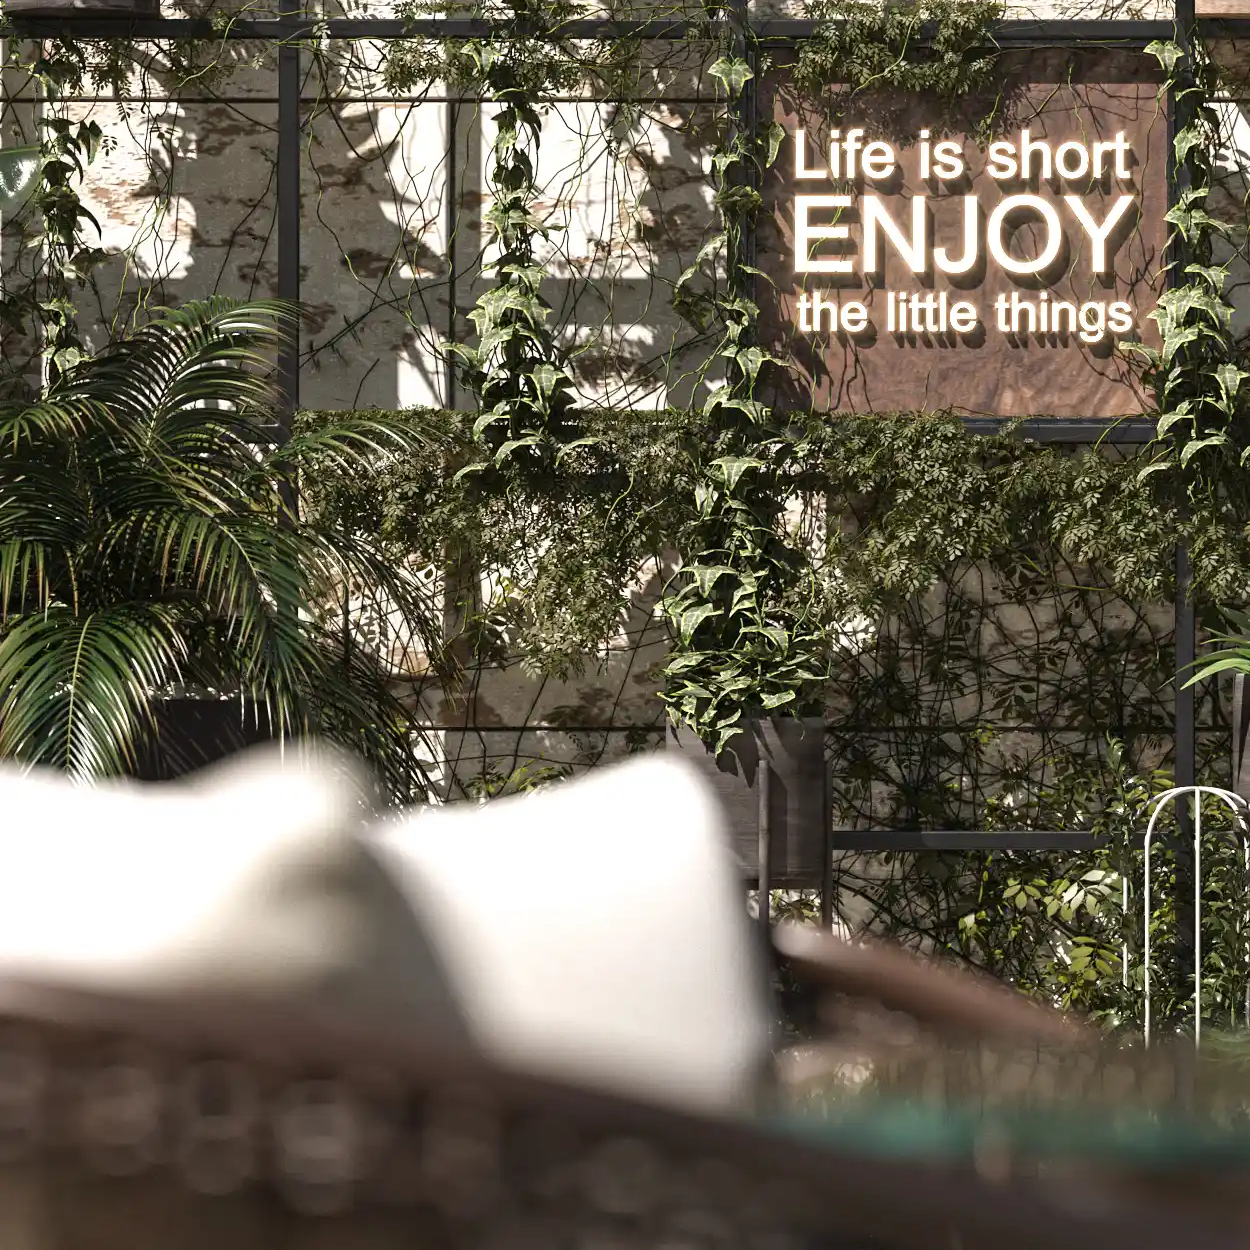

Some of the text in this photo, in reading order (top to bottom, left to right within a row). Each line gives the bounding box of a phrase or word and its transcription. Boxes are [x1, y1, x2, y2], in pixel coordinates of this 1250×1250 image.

[794, 127, 1133, 181] Life is short
[793, 193, 1136, 275] ENJOY
[795, 290, 1134, 344] the little things
